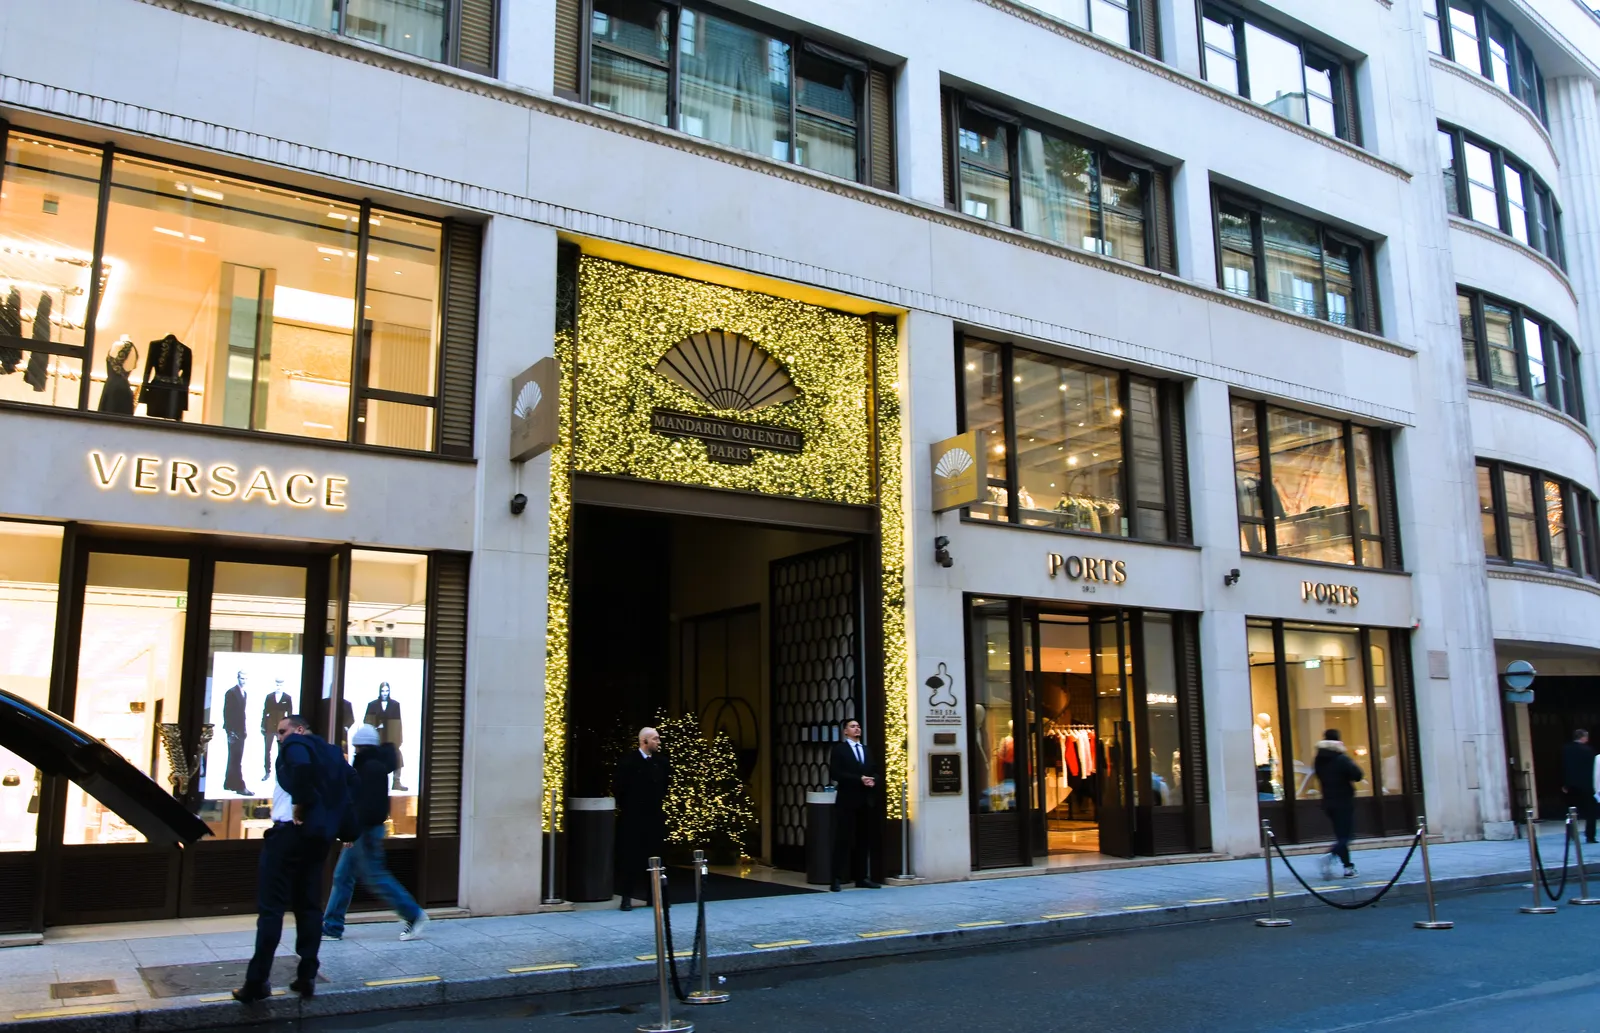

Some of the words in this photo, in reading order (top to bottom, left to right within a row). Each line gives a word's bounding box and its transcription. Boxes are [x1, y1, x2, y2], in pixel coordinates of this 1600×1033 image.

[653, 414, 728, 437] MANDARIN
[732, 426, 801, 447] ORIENTAL
[709, 444, 749, 460] PARIS
[91, 452, 348, 509] VERSACE
[1047, 552, 1128, 585] PORTS
[1300, 580, 1360, 607] PORTS
